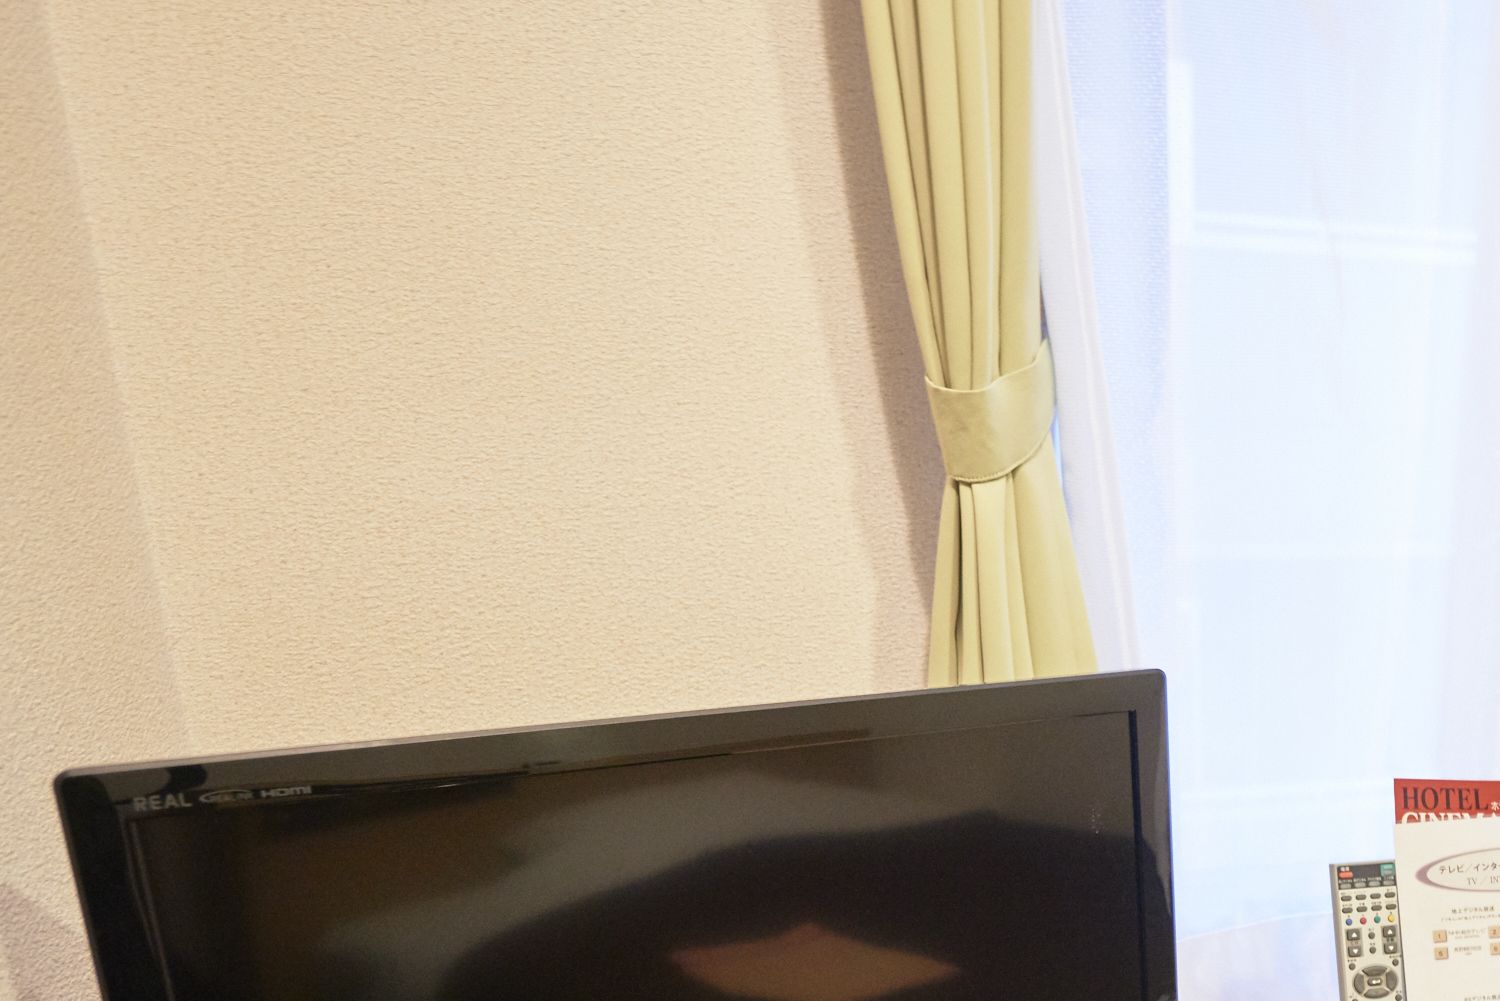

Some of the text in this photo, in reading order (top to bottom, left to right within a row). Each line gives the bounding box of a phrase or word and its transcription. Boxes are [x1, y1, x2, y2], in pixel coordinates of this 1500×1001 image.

[260, 785, 313, 799] HDMI
[1402, 786, 1489, 811] HOTEL
[132, 793, 193, 812] REAL
[1467, 877, 1478, 886] TV
